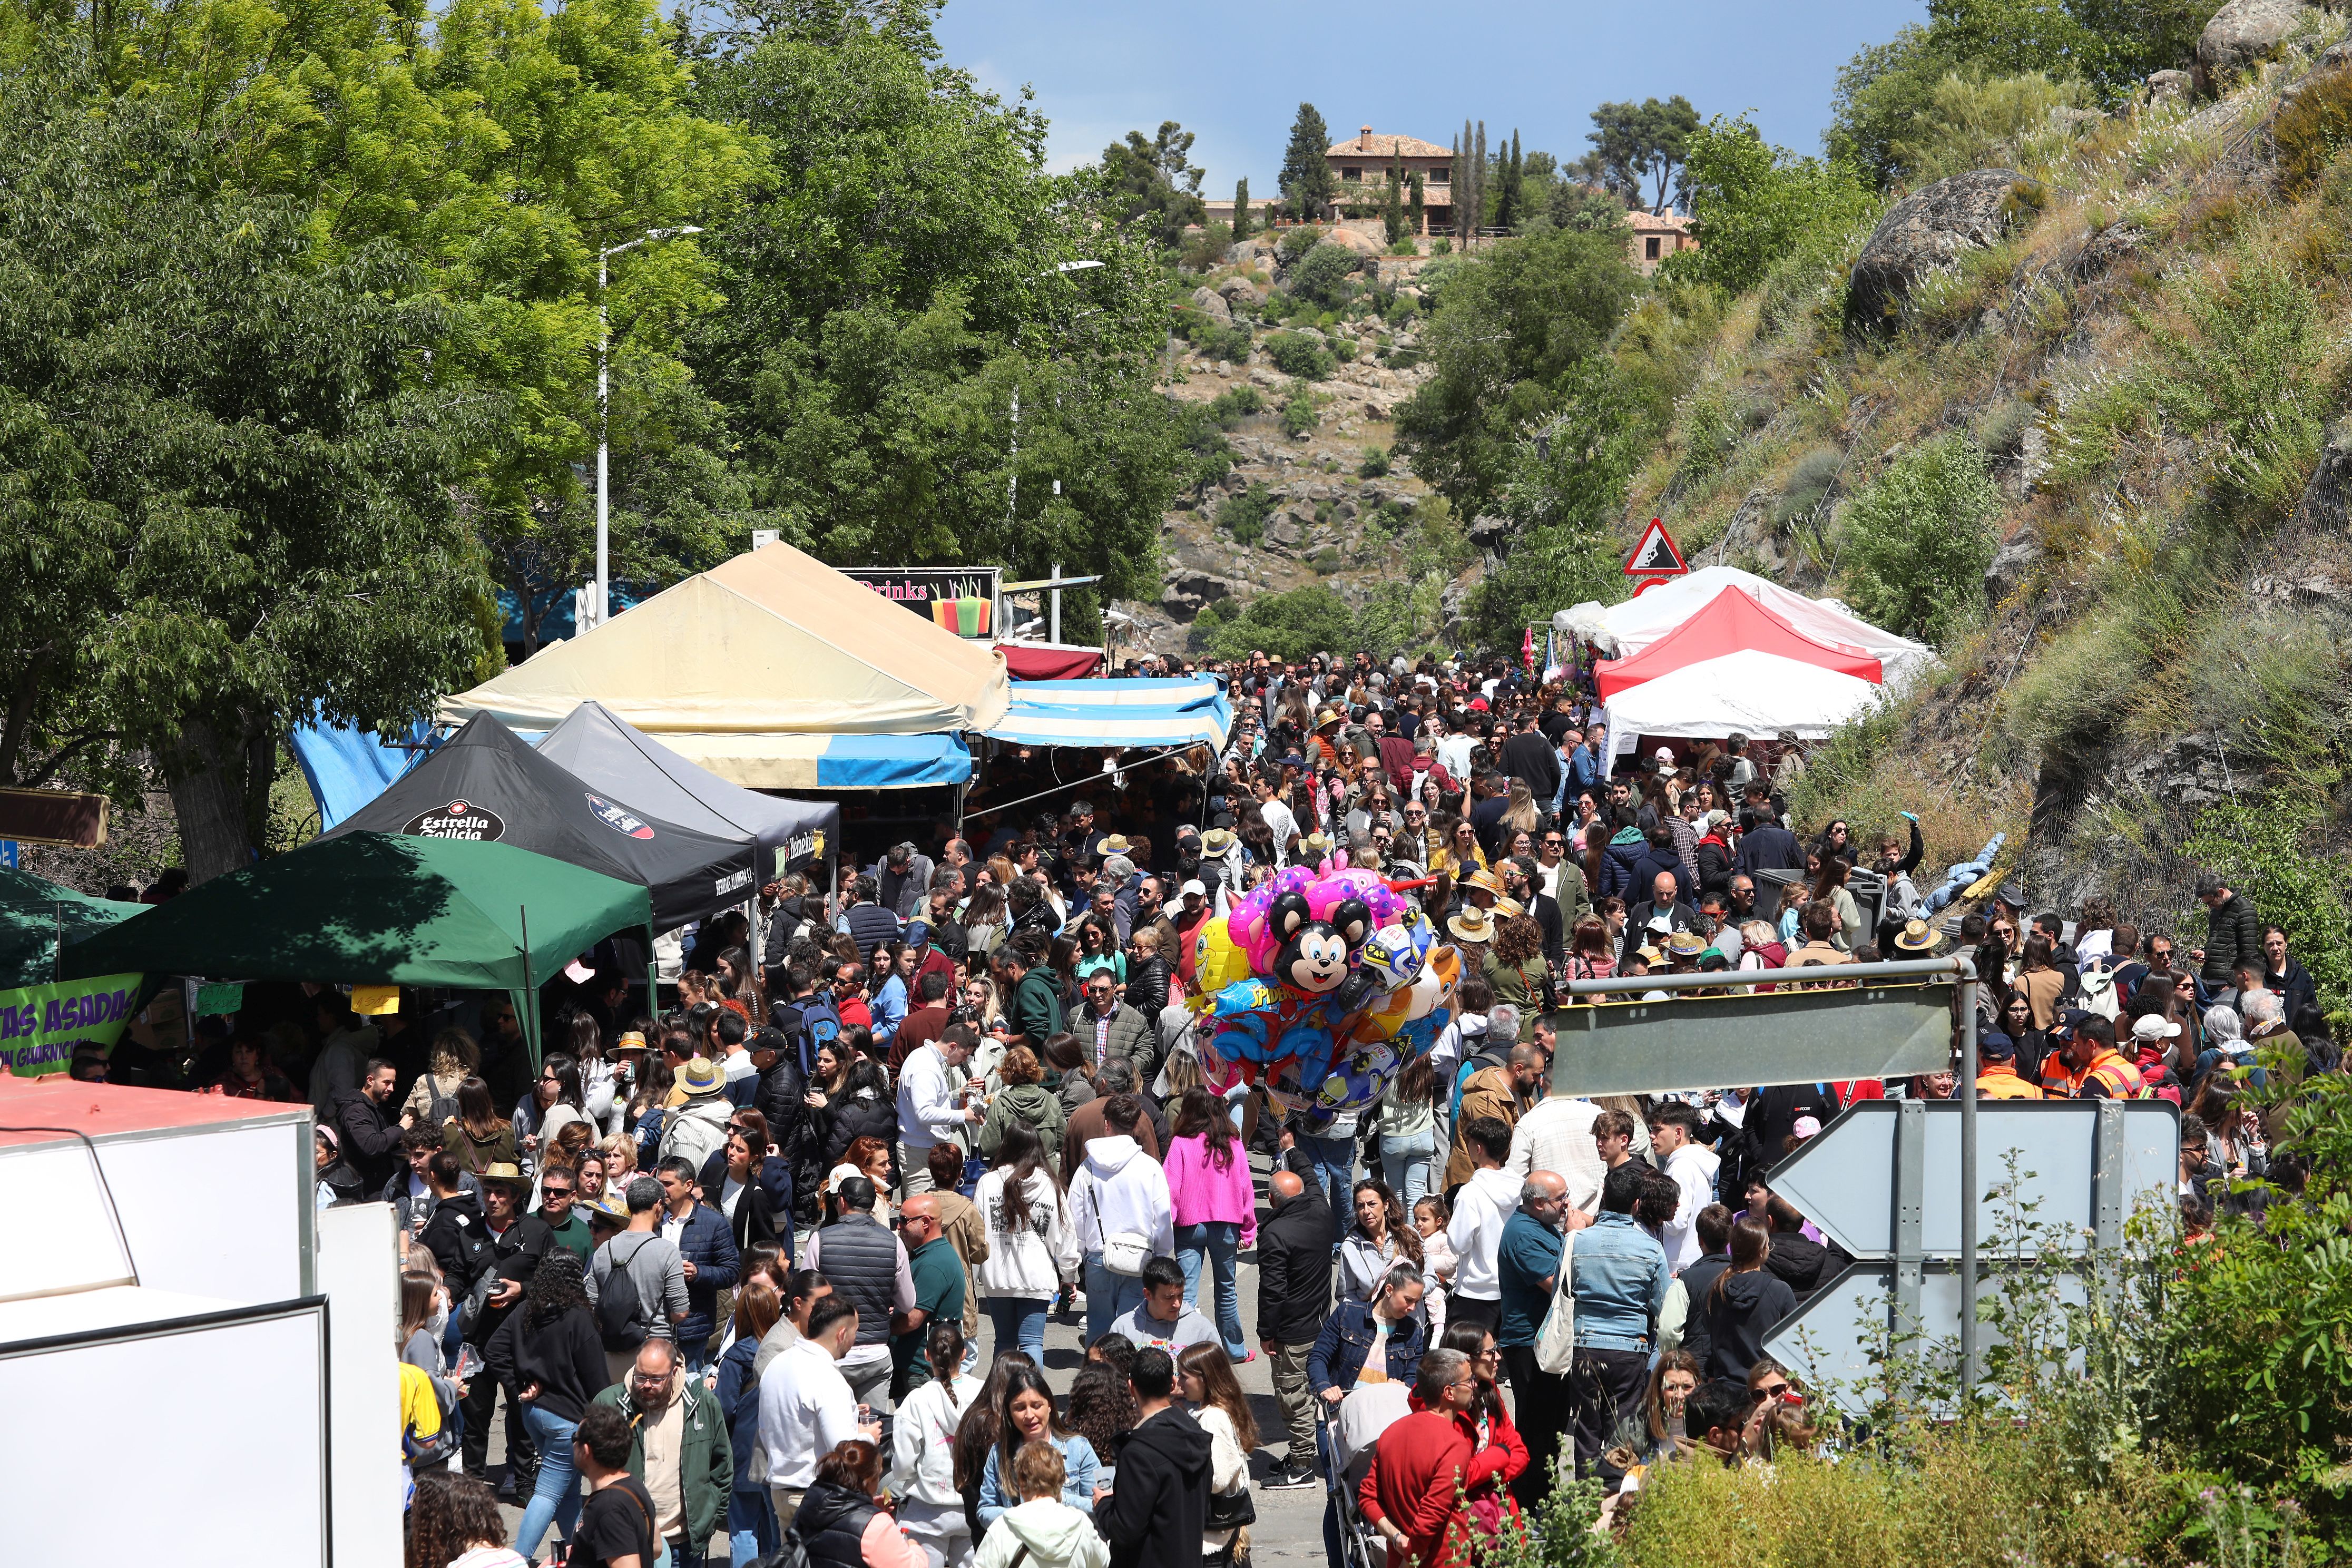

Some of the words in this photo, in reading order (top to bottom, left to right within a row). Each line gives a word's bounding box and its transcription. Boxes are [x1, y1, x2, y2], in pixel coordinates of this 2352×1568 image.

[856, 580, 927, 601] rinks
[419, 816, 489, 830] Estrella
[790, 832, 815, 860] Heineke
[715, 877, 731, 896] BEBIDAS
[730, 868, 748, 890] ALAMEDA
[1373, 950, 1385, 958] 45
[0, 1003, 37, 1041] AS
[43, 986, 138, 1034] ASADAS
[16, 1034, 92, 1067] GUARNICI
[1398, 1041, 1406, 1054] 45
[1319, 1092, 1334, 1104] 45
